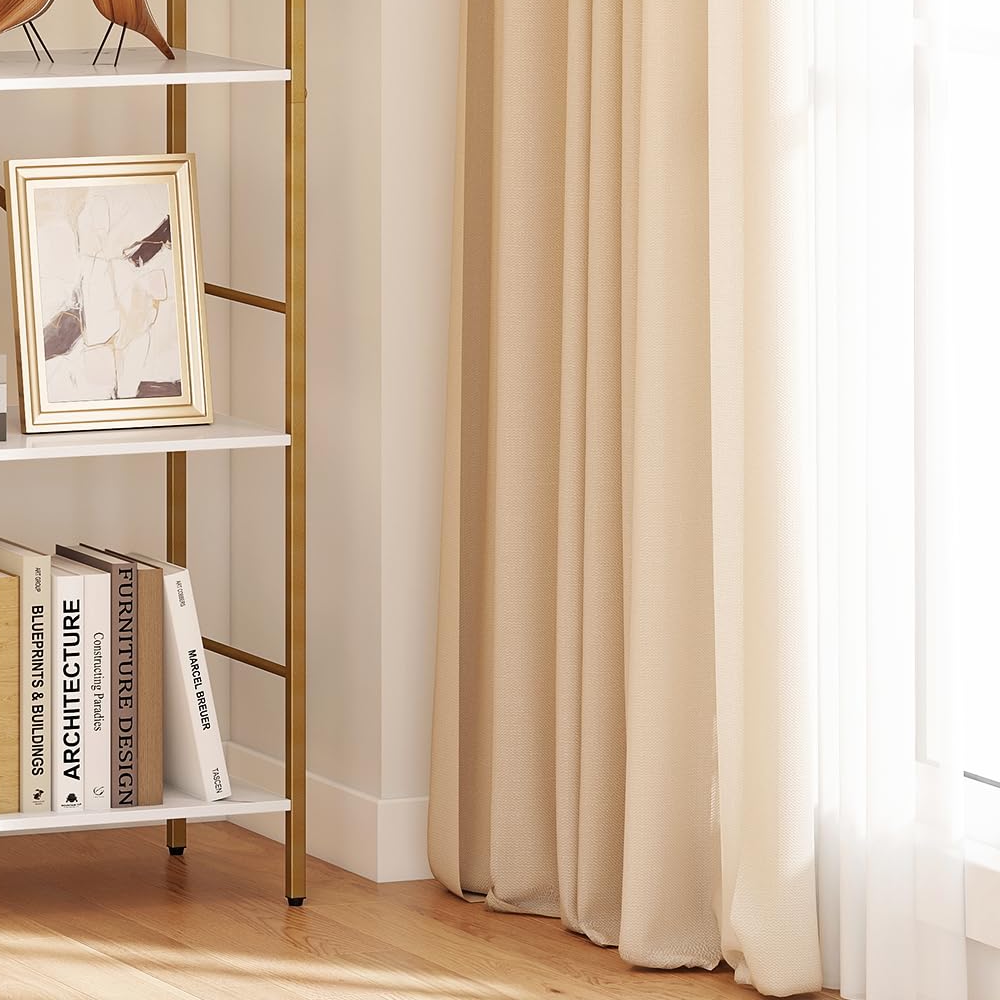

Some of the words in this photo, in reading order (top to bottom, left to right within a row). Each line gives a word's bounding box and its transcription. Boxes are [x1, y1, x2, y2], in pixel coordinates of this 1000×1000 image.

[31, 605, 44, 688] BLUEPRINTS
[91, 632, 104, 690] Constructing
[118, 567, 133, 709] FURNITURE
[31, 692, 44, 701] &
[63, 599, 80, 781] ARCHITECTURE
[188, 649, 203, 690] MARCEL
[196, 691, 211, 731] BREUER
[31, 704, 44, 776] BUILDINGS
[118, 718, 133, 806] DESIGN
